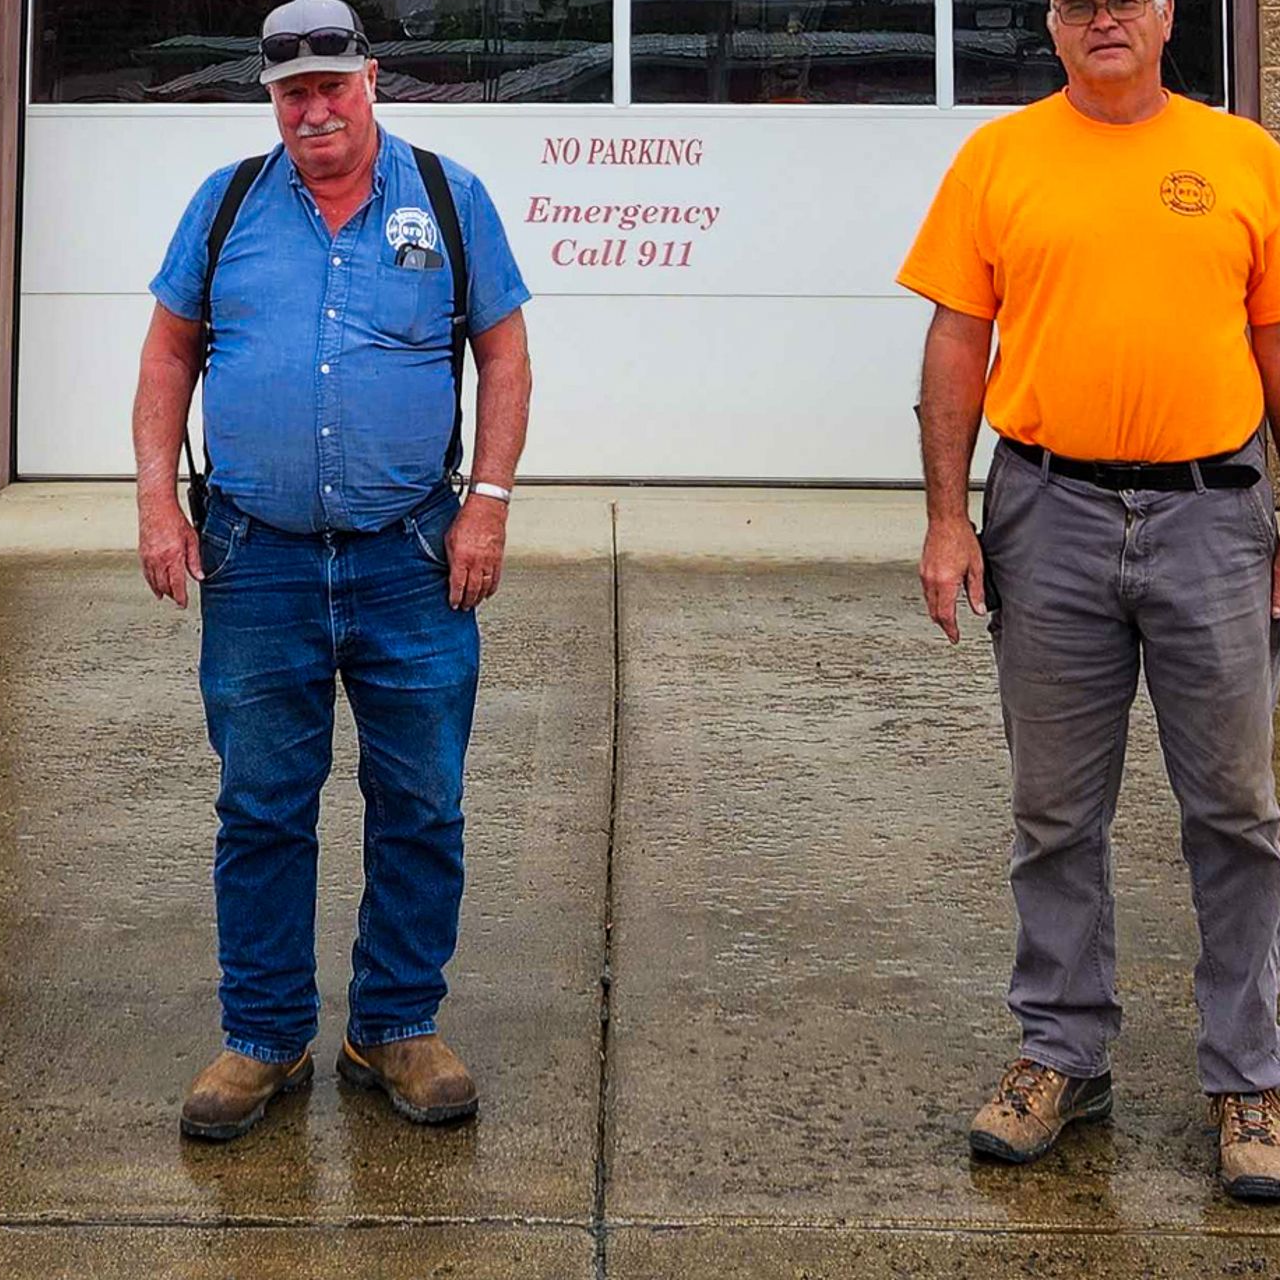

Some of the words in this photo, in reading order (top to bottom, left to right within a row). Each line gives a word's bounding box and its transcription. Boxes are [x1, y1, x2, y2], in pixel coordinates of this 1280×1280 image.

[541, 138, 580, 165] NO
[587, 138, 704, 165] PARKING
[525, 197, 720, 231] Emergency
[551, 238, 628, 267] Call
[638, 239, 694, 268] 911
